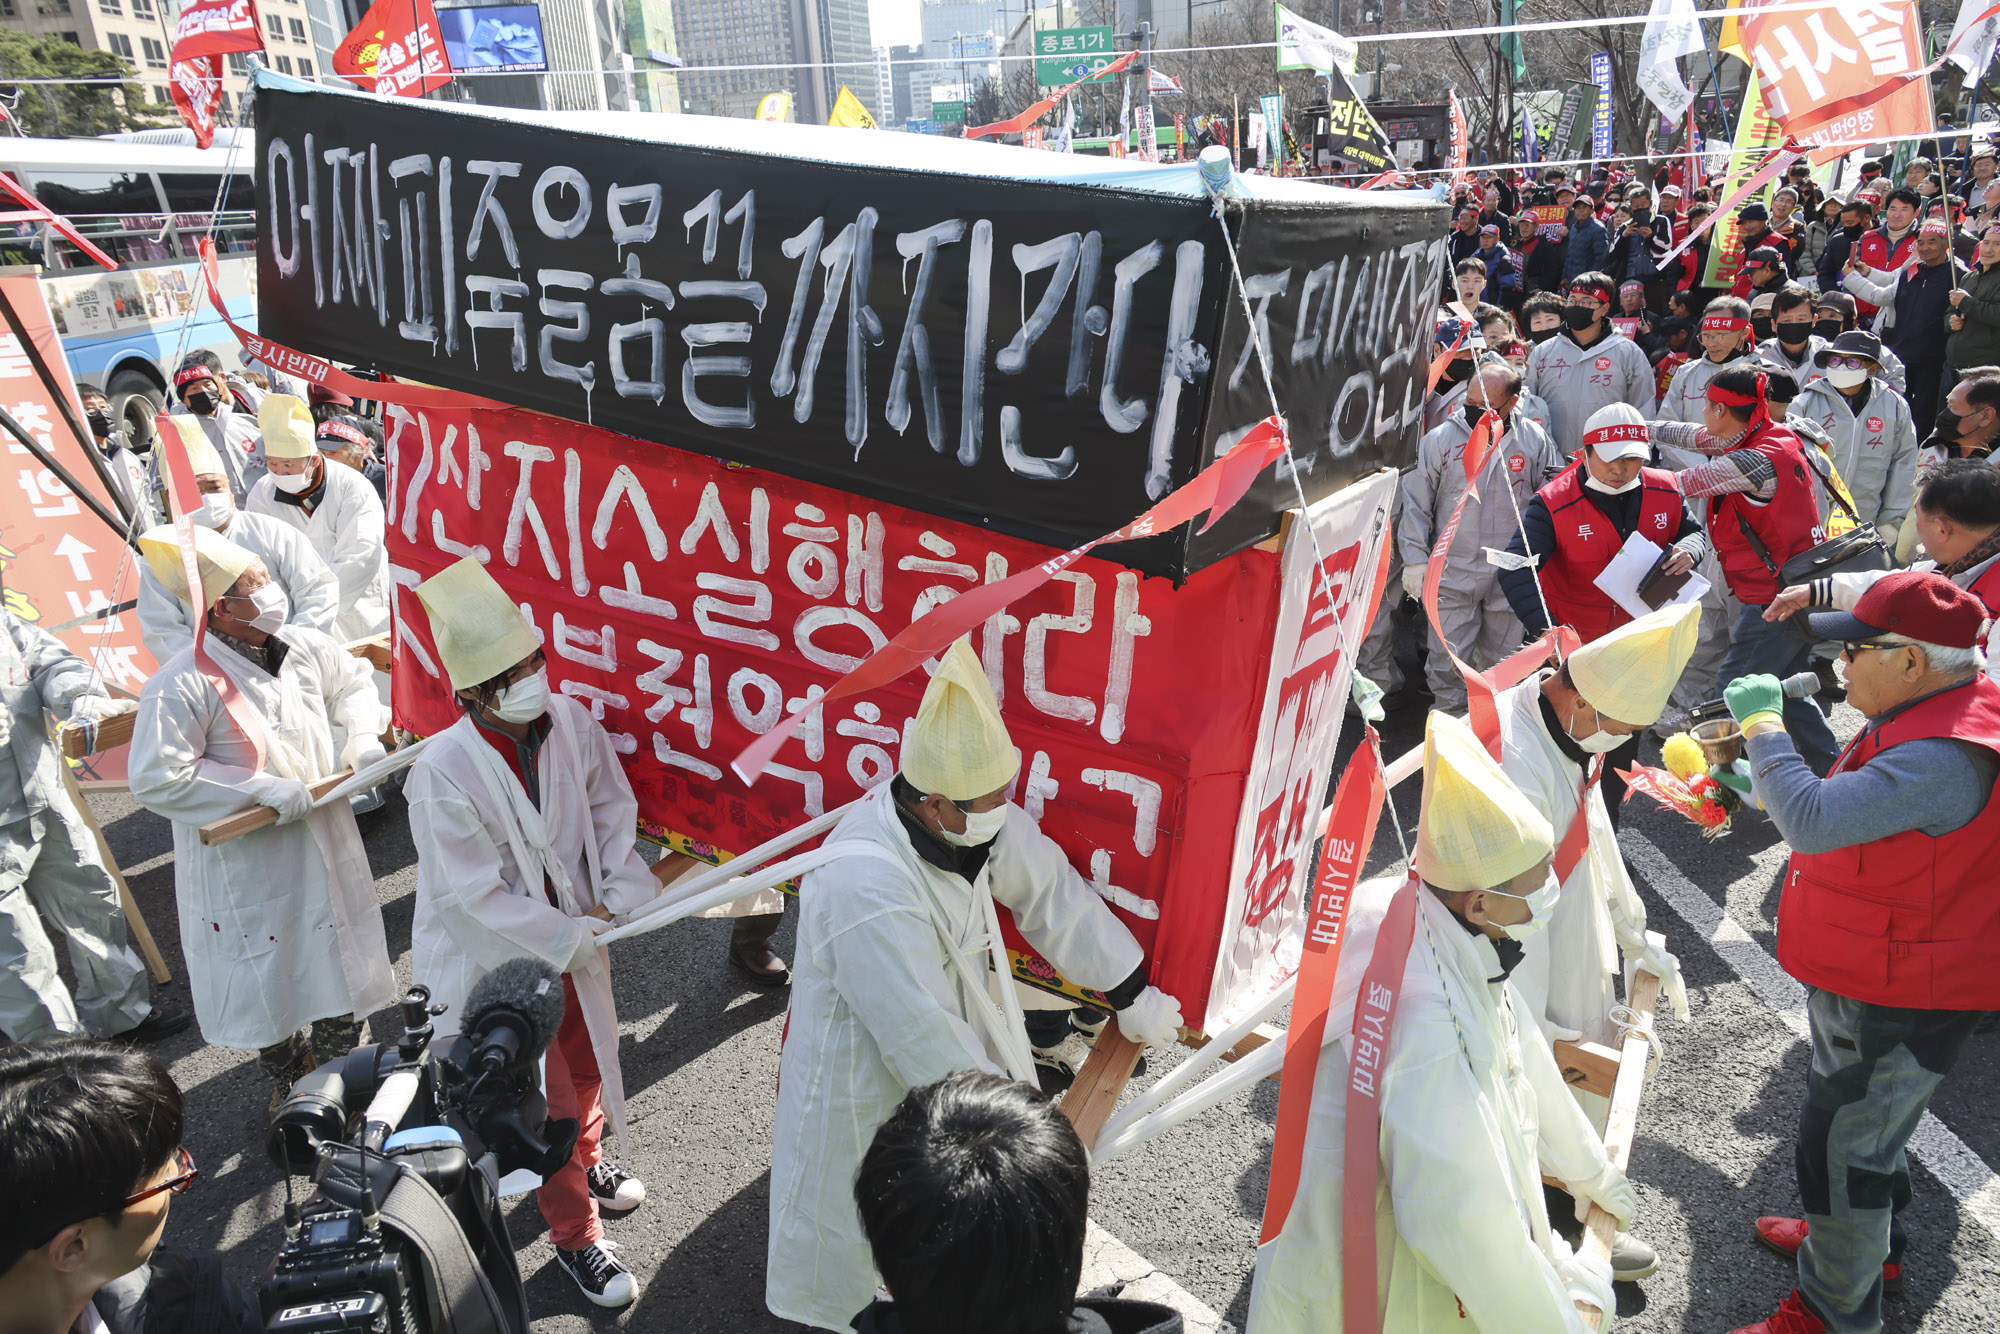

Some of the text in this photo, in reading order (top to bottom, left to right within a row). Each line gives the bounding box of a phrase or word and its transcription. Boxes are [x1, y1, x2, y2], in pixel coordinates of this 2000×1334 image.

[1041, 32, 1105, 53] 종로1가
[1077, 66, 1084, 76] 6
[246, 335, 329, 383] 결사반대
[1577, 512, 1669, 541] 투 쟁
[1312, 838, 1355, 945] 결사반대
